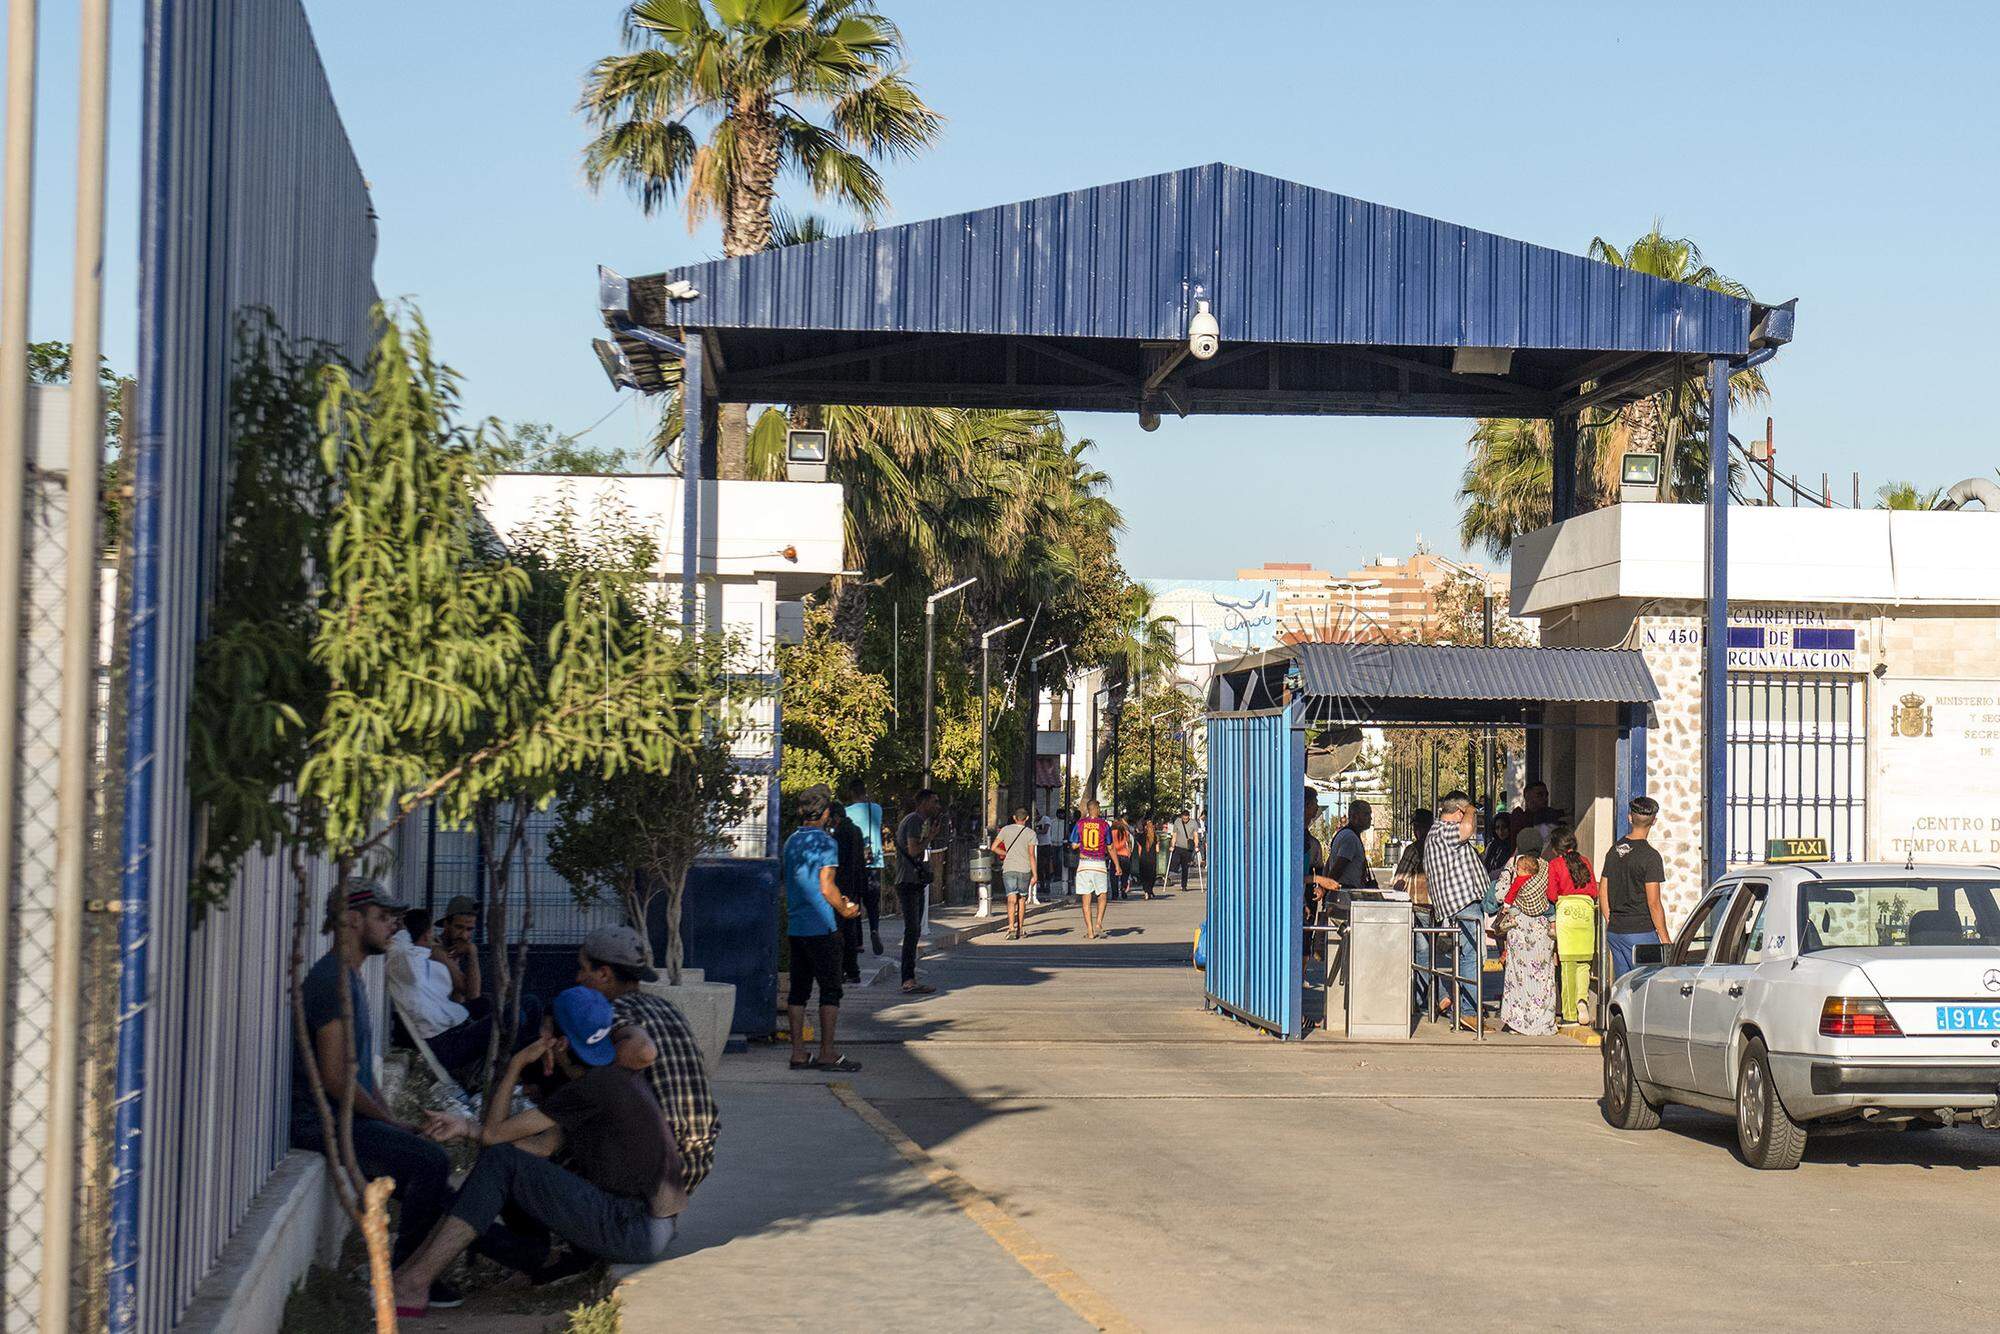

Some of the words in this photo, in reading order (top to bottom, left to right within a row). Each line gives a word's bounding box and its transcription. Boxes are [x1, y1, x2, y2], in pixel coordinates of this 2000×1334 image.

[1733, 609, 1825, 625] CARRETERA
[1668, 629, 1698, 644] 450
[1769, 631, 1789, 645] DE
[1728, 651, 1851, 667] RCUNVALACION
[1935, 696, 1994, 706] MINISTERIO
[1917, 816, 1984, 831] CENTRO
[1082, 829, 1099, 848] 10
[1892, 838, 1983, 853] TEMPORAL
[1787, 841, 1822, 855] TAXI
